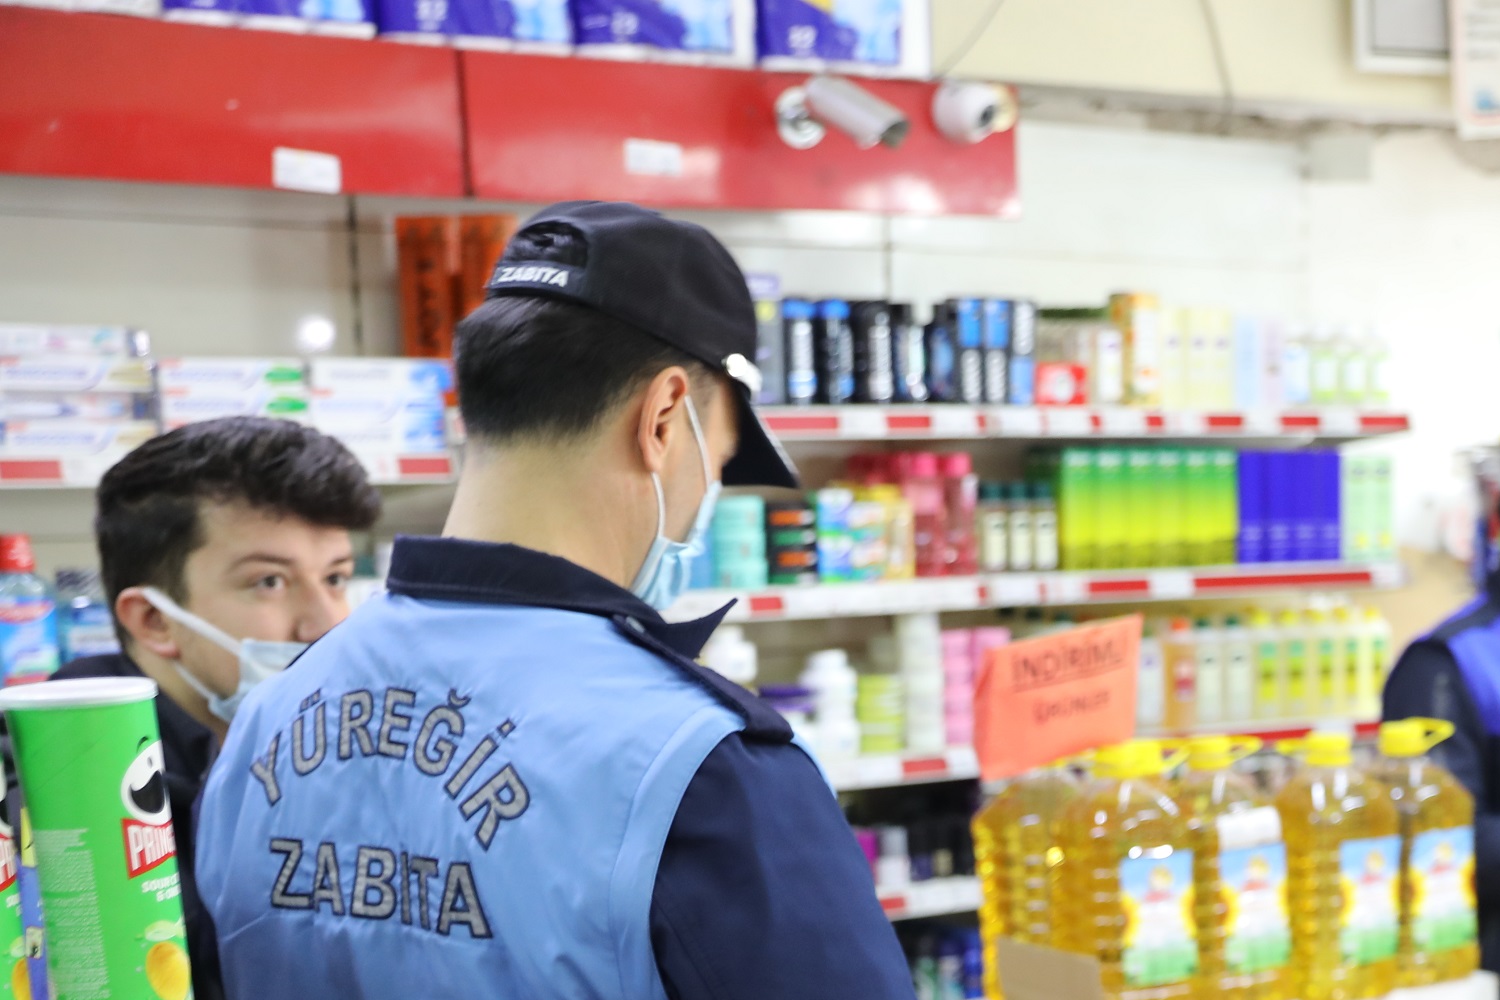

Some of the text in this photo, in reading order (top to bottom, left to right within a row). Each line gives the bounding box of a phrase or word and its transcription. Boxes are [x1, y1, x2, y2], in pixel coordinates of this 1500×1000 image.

[497, 266, 569, 287] ZABITA
[250, 687, 532, 852] YÜREĞİR
[269, 837, 494, 940] ZABITA
